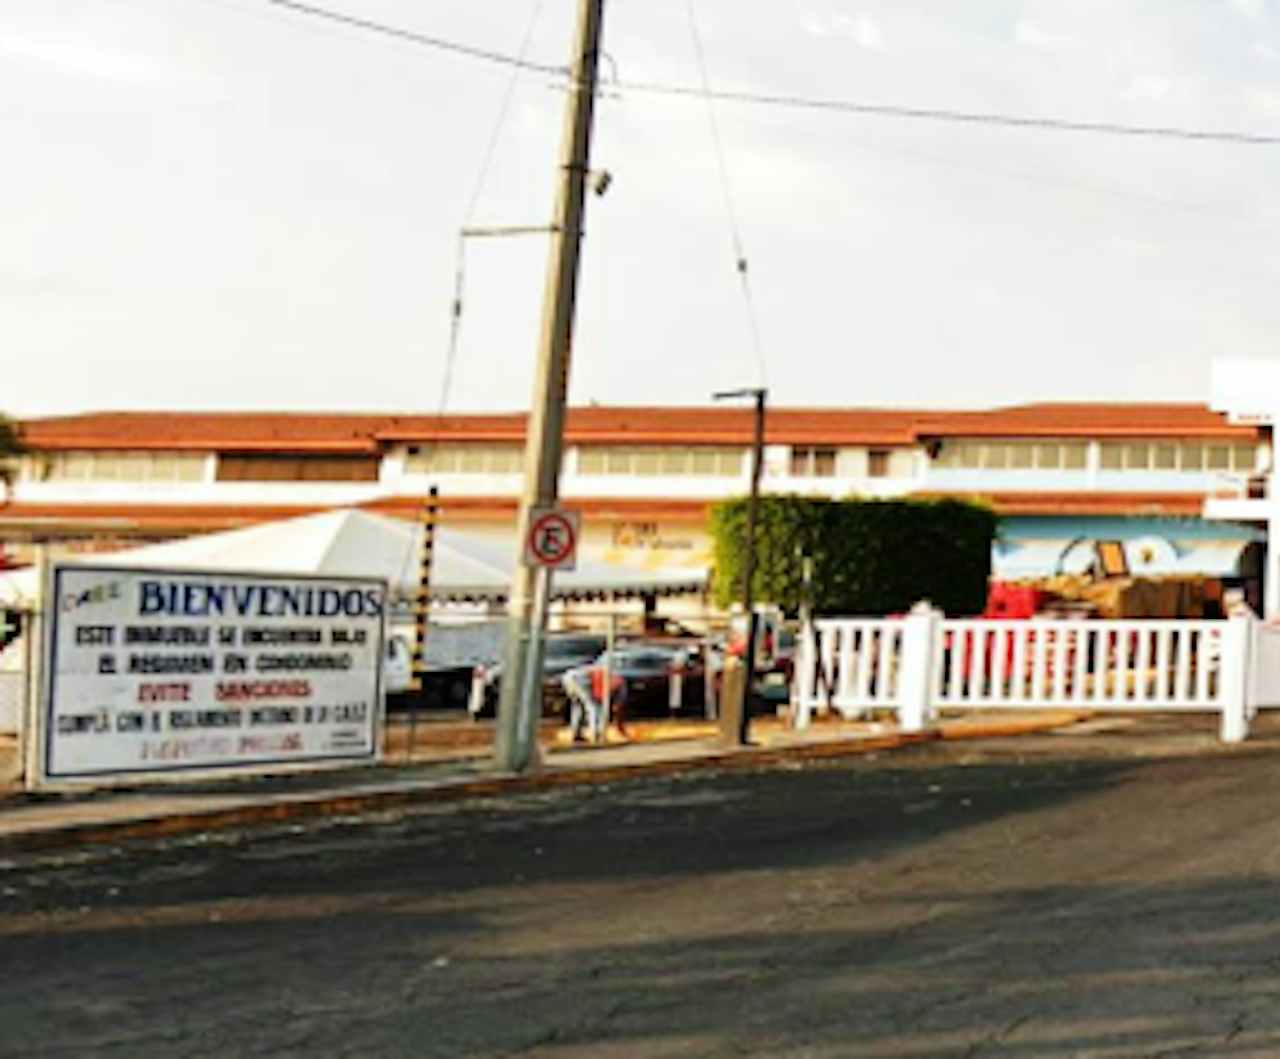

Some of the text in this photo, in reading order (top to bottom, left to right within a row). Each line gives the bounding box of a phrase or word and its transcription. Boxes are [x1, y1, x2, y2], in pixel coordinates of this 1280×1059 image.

[138, 581, 383, 617] BIENVENIDOS
[75, 625, 117, 647] ESTE
[137, 679, 313, 704] EVITE SANCIONES
